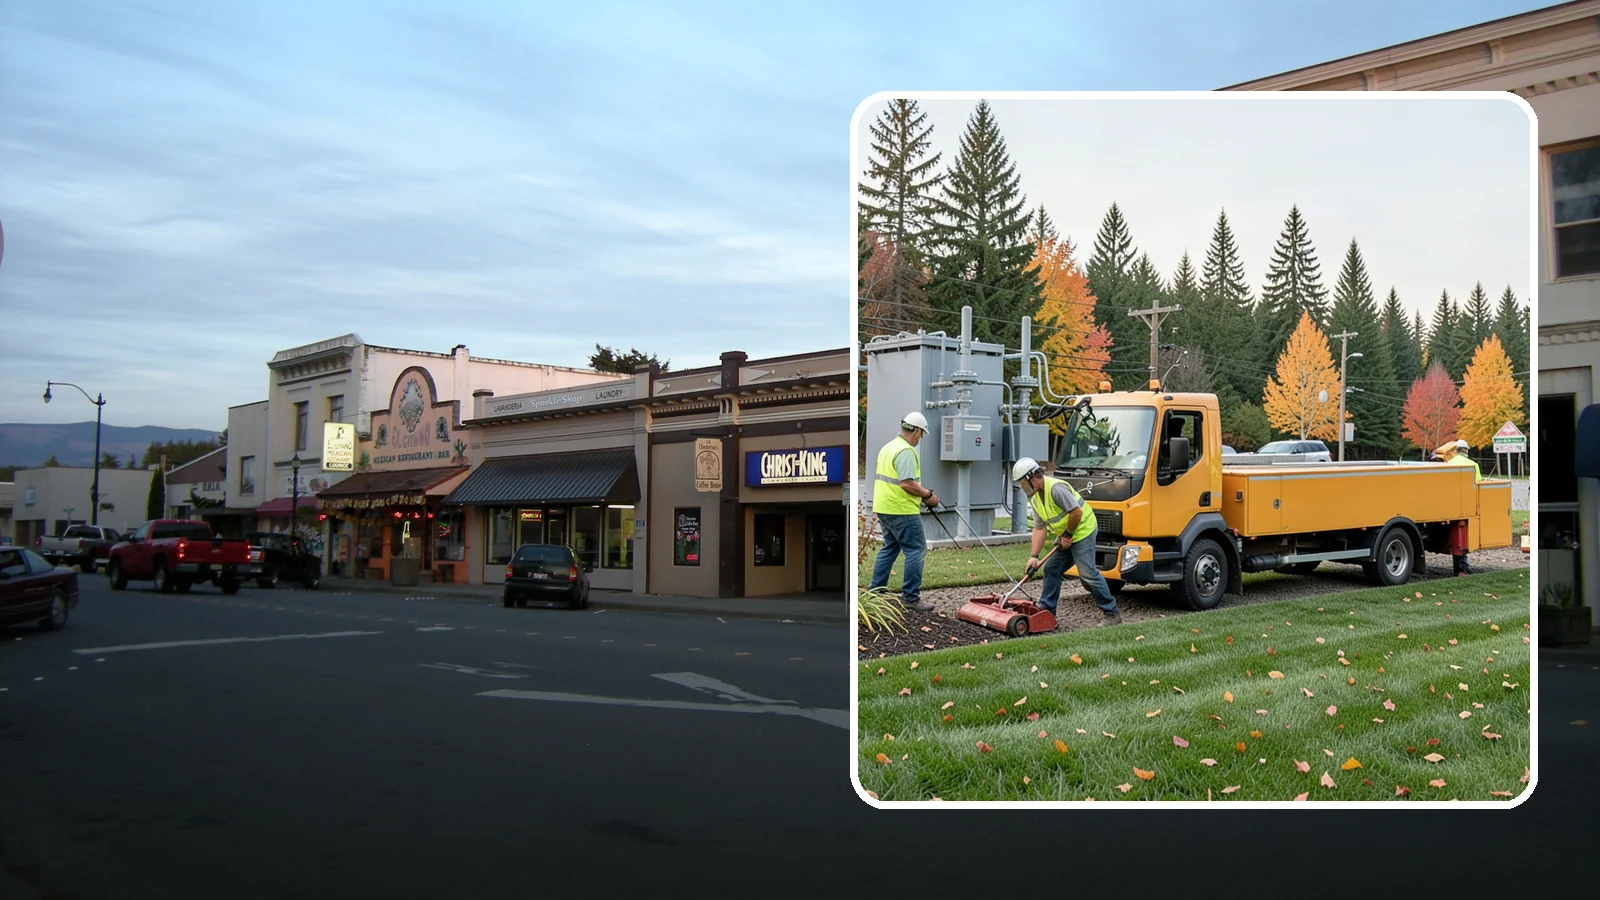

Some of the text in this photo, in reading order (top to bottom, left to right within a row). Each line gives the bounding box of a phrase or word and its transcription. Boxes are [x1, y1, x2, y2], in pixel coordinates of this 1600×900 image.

[595, 388, 624, 400] LAUNDRY
[493, 402, 522, 412] LAVANDERIA
[531, 394, 583, 409] Sparkle Shop
[374, 450, 450, 464] MEXICAN RESTAURANT BAR
[761, 450, 827, 478] CHRIST KING
